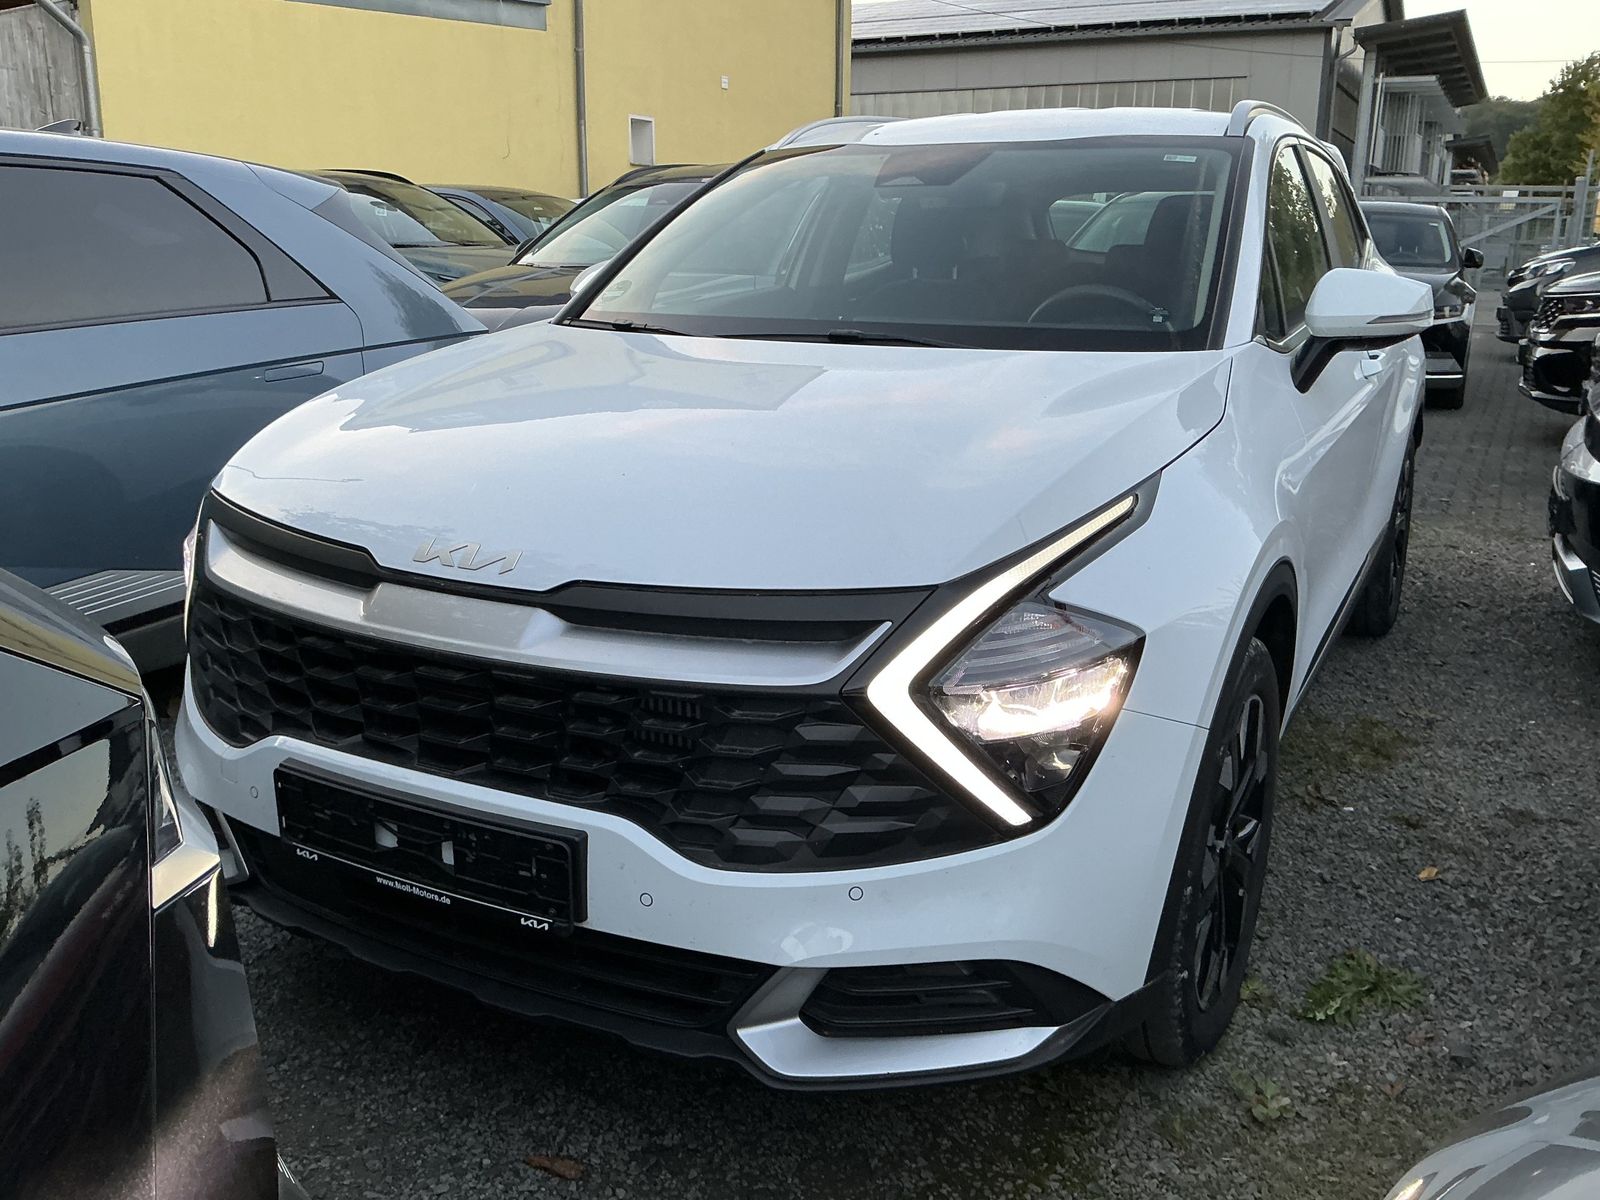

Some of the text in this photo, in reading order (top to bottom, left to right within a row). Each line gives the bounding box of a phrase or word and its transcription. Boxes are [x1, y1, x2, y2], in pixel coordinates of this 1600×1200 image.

[413, 537, 524, 575] KIA
[296, 848, 318, 861] KIA
[520, 917, 549, 931] KIA
